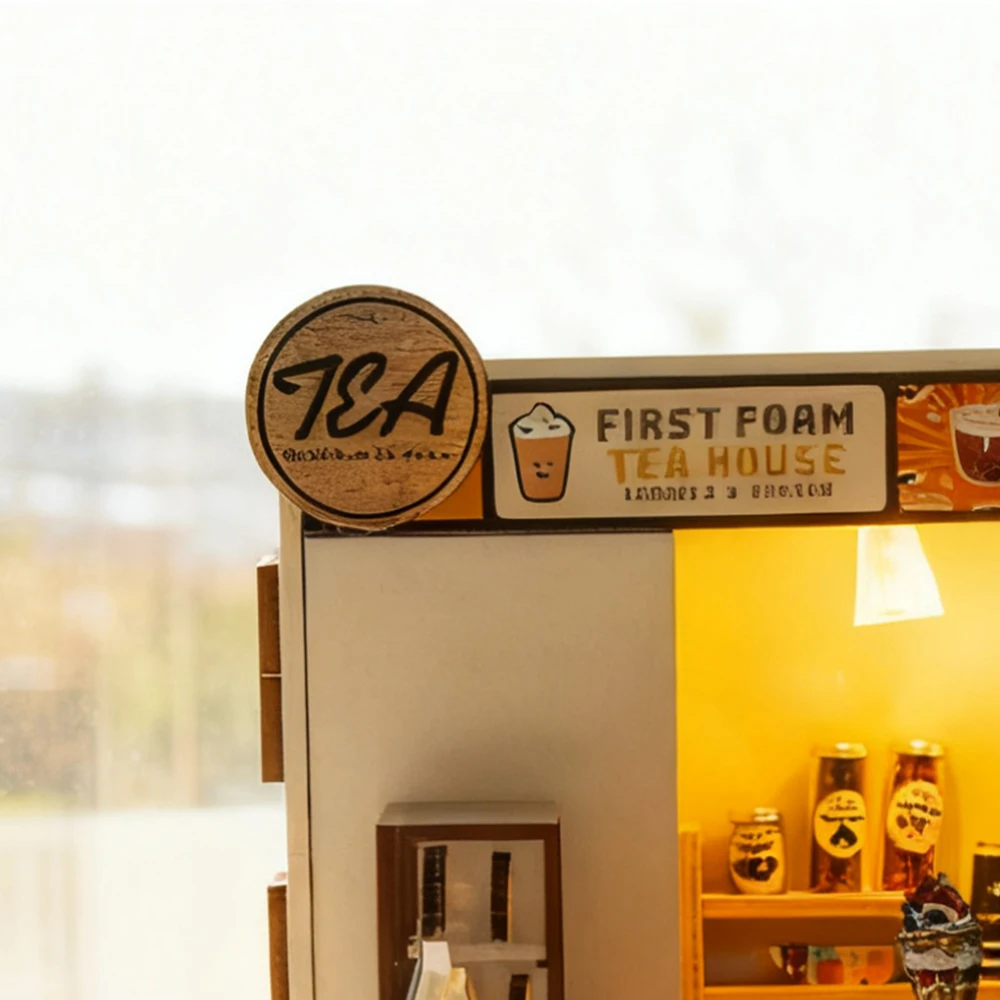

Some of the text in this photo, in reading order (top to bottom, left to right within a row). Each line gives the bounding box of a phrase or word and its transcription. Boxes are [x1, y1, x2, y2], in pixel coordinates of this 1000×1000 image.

[272, 350, 460, 441] TEA
[597, 401, 854, 442] FIRST FOAM
[606, 443, 847, 485] TEA HOUSE
